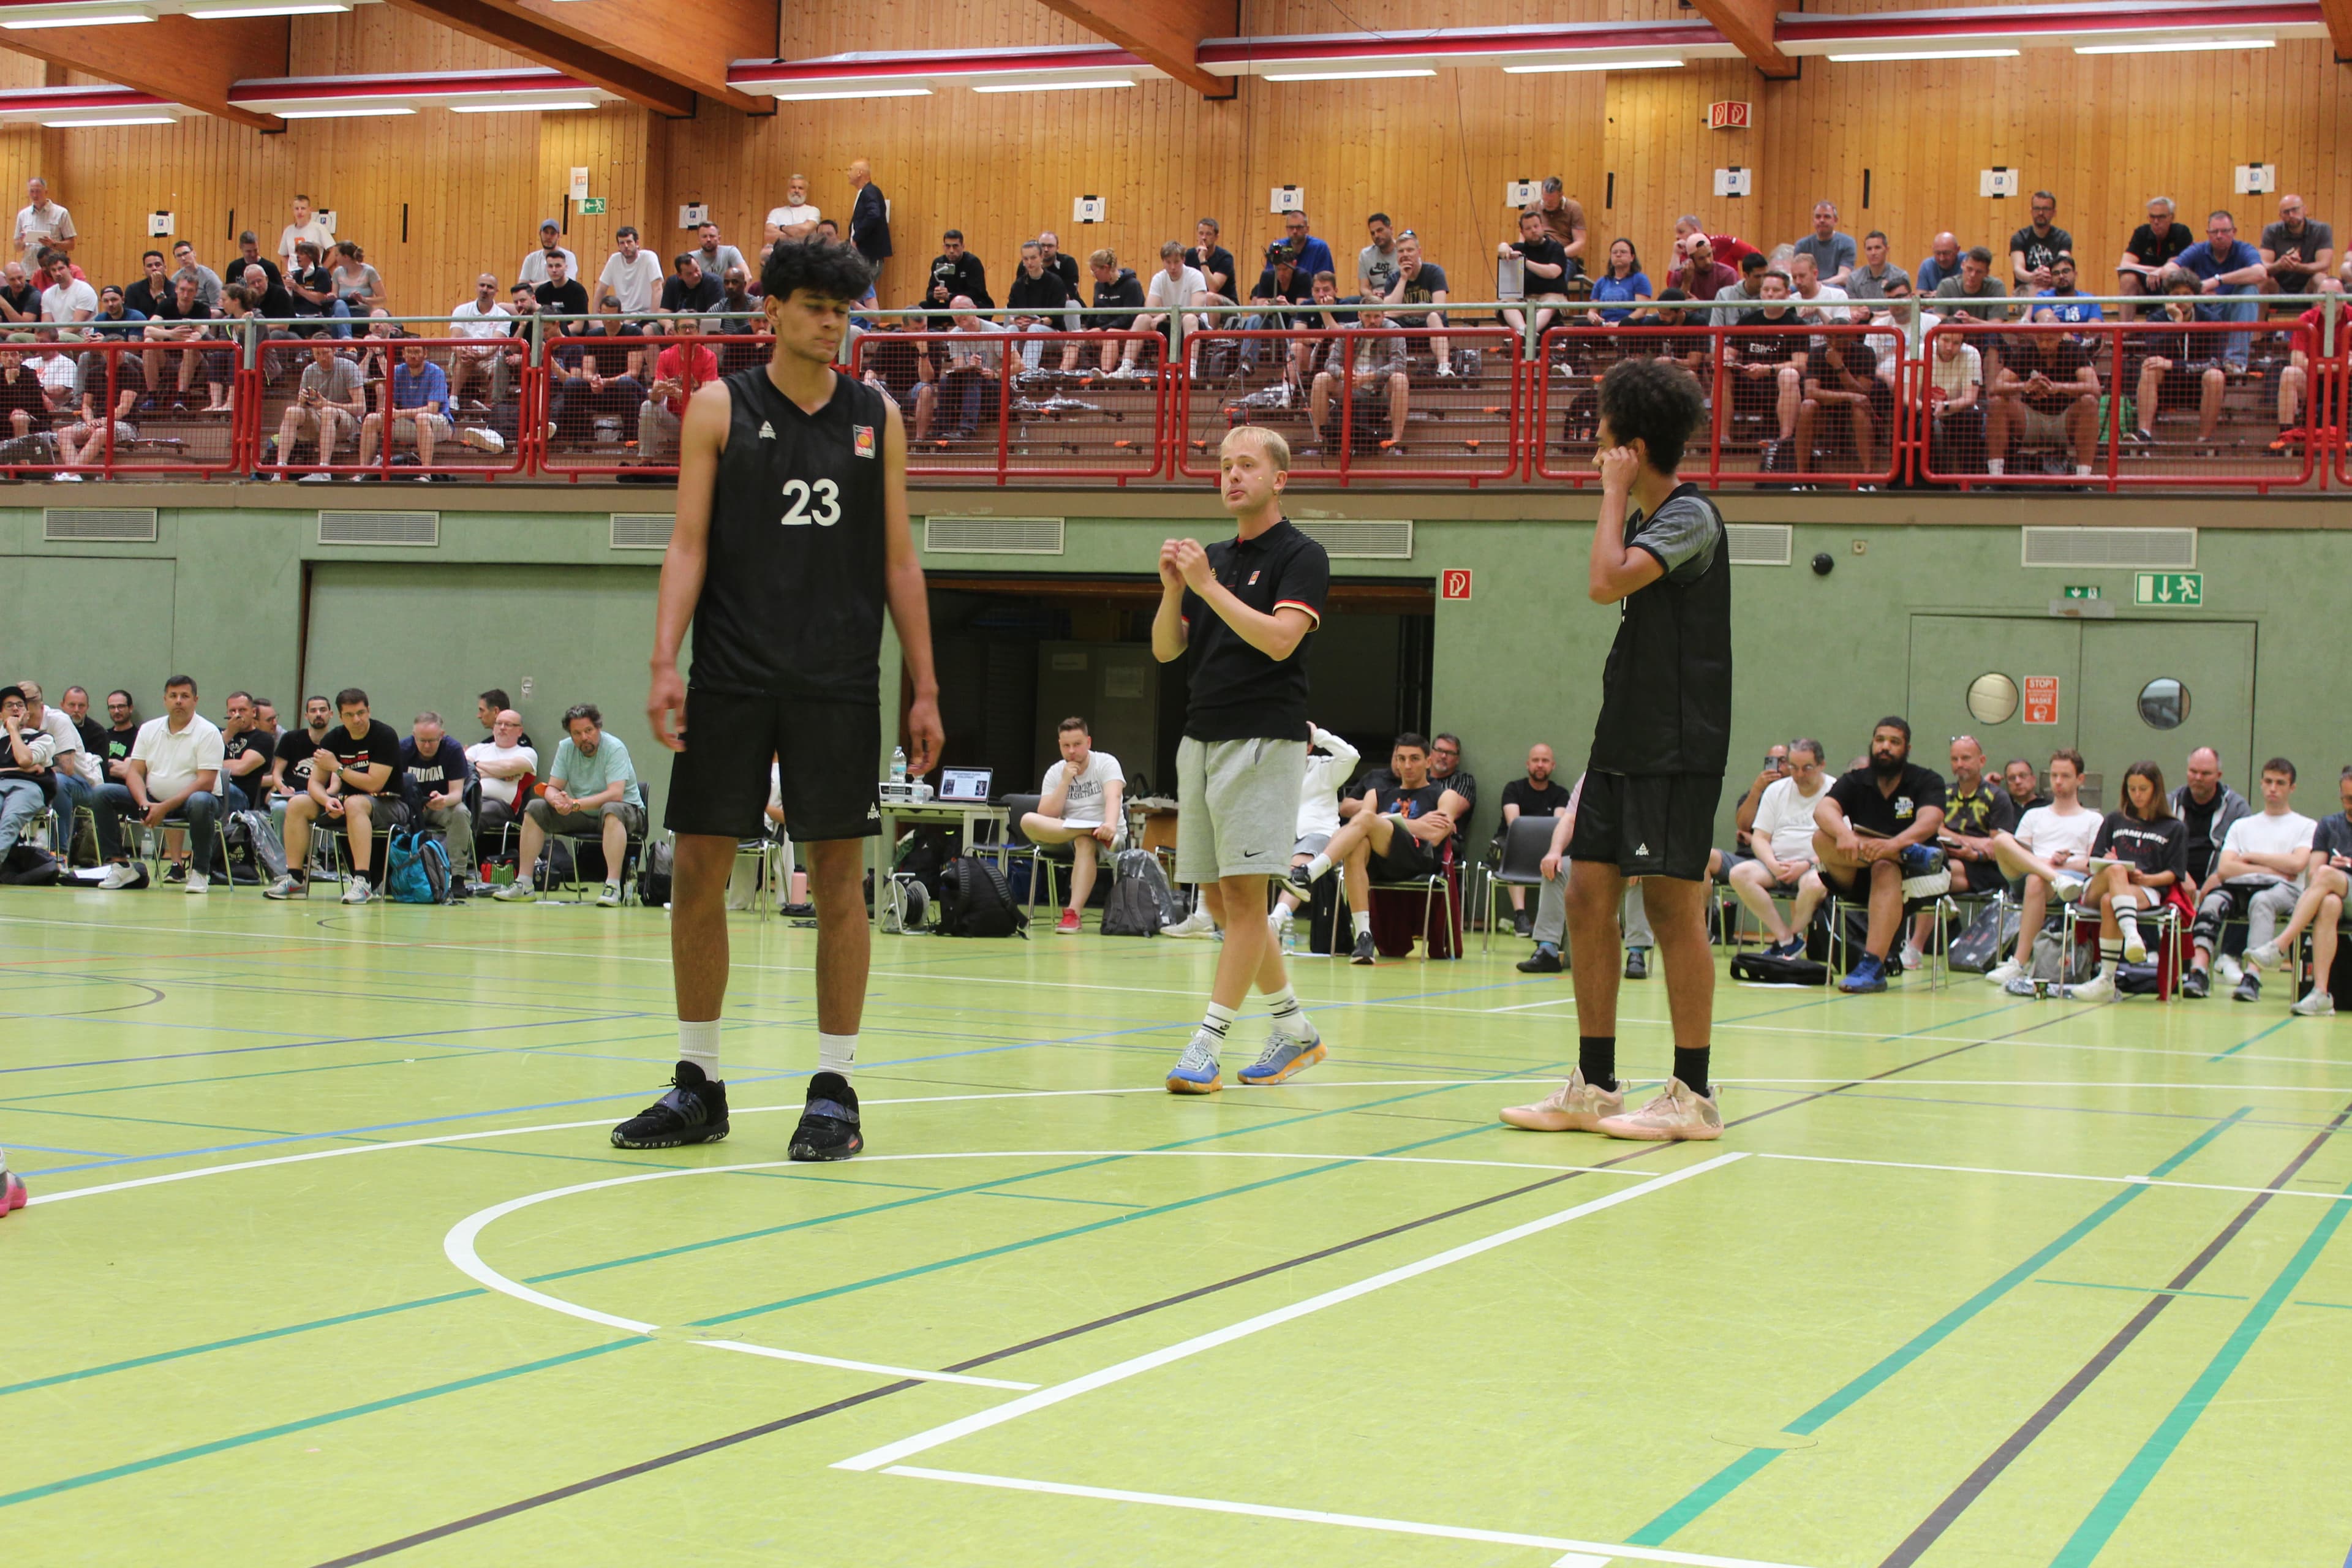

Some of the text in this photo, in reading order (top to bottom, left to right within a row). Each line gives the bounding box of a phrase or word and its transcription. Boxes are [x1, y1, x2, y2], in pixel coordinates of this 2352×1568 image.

[781, 478, 841, 527] 23
[2029, 679, 2054, 688] STOP!
[408, 765, 444, 783] PUMA
[1068, 780, 1093, 793] NDATION
[2112, 829, 2143, 839] MIAMI
[2142, 832, 2169, 845] HEAT
